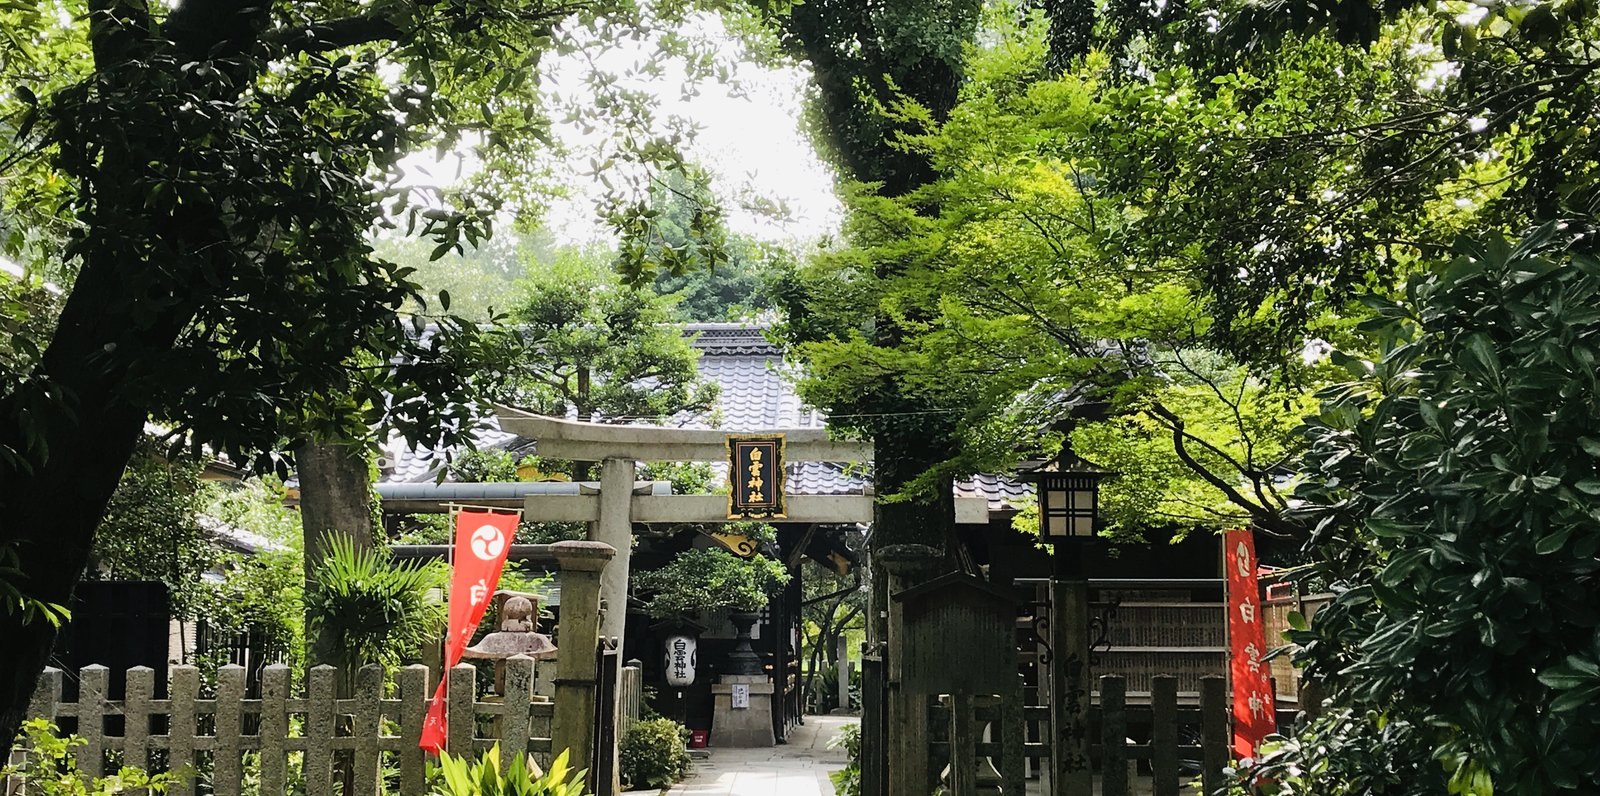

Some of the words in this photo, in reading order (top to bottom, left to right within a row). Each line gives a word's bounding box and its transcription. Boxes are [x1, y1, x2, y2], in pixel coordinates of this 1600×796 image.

[748, 447, 764, 503] 白雲神社
[673, 639, 687, 679] 白雲神社
[1060, 652, 1088, 774] 白雲神社
